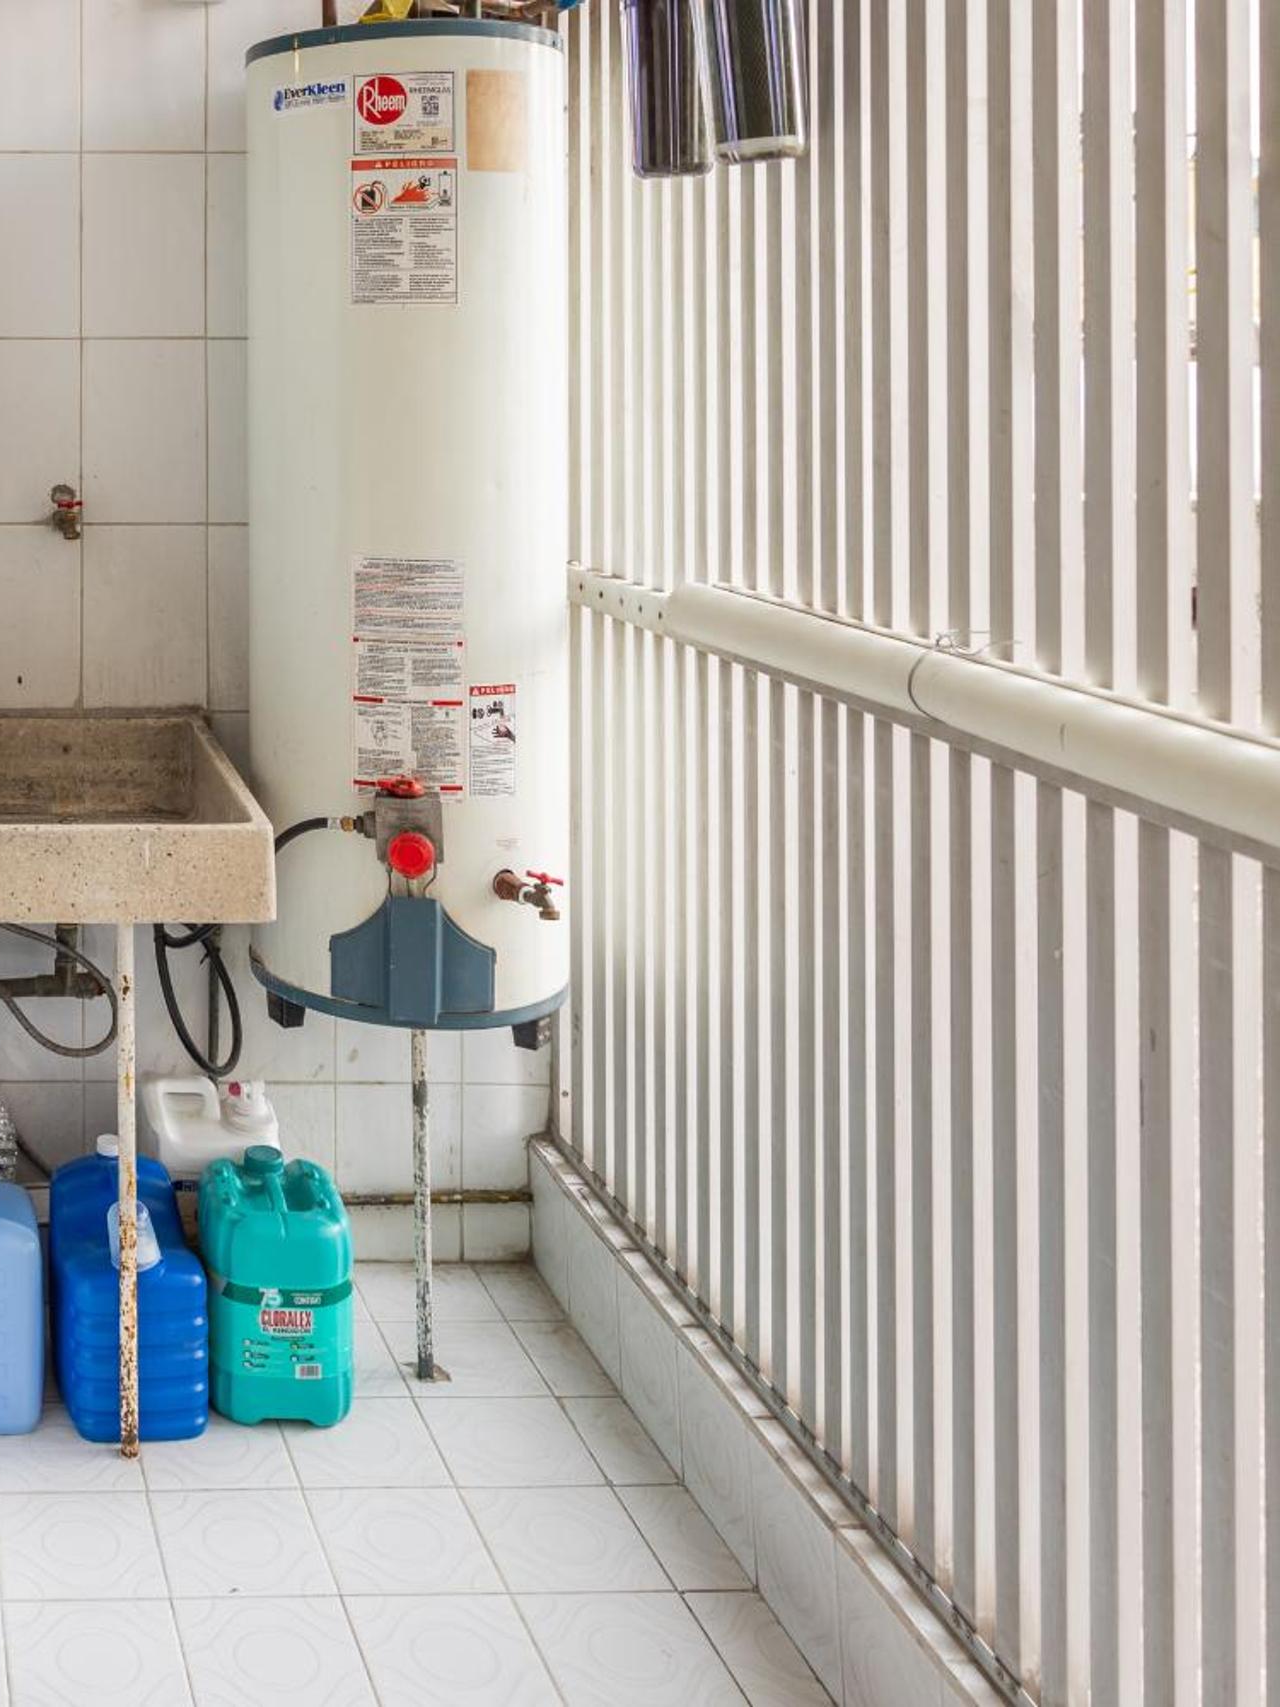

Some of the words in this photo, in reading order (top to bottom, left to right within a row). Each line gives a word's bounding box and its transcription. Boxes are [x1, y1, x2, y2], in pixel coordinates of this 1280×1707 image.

[362, 76, 406, 119] Rheem
[385, 160, 435, 168] PELIGRO
[261, 1309, 312, 1328] CLORALEX
